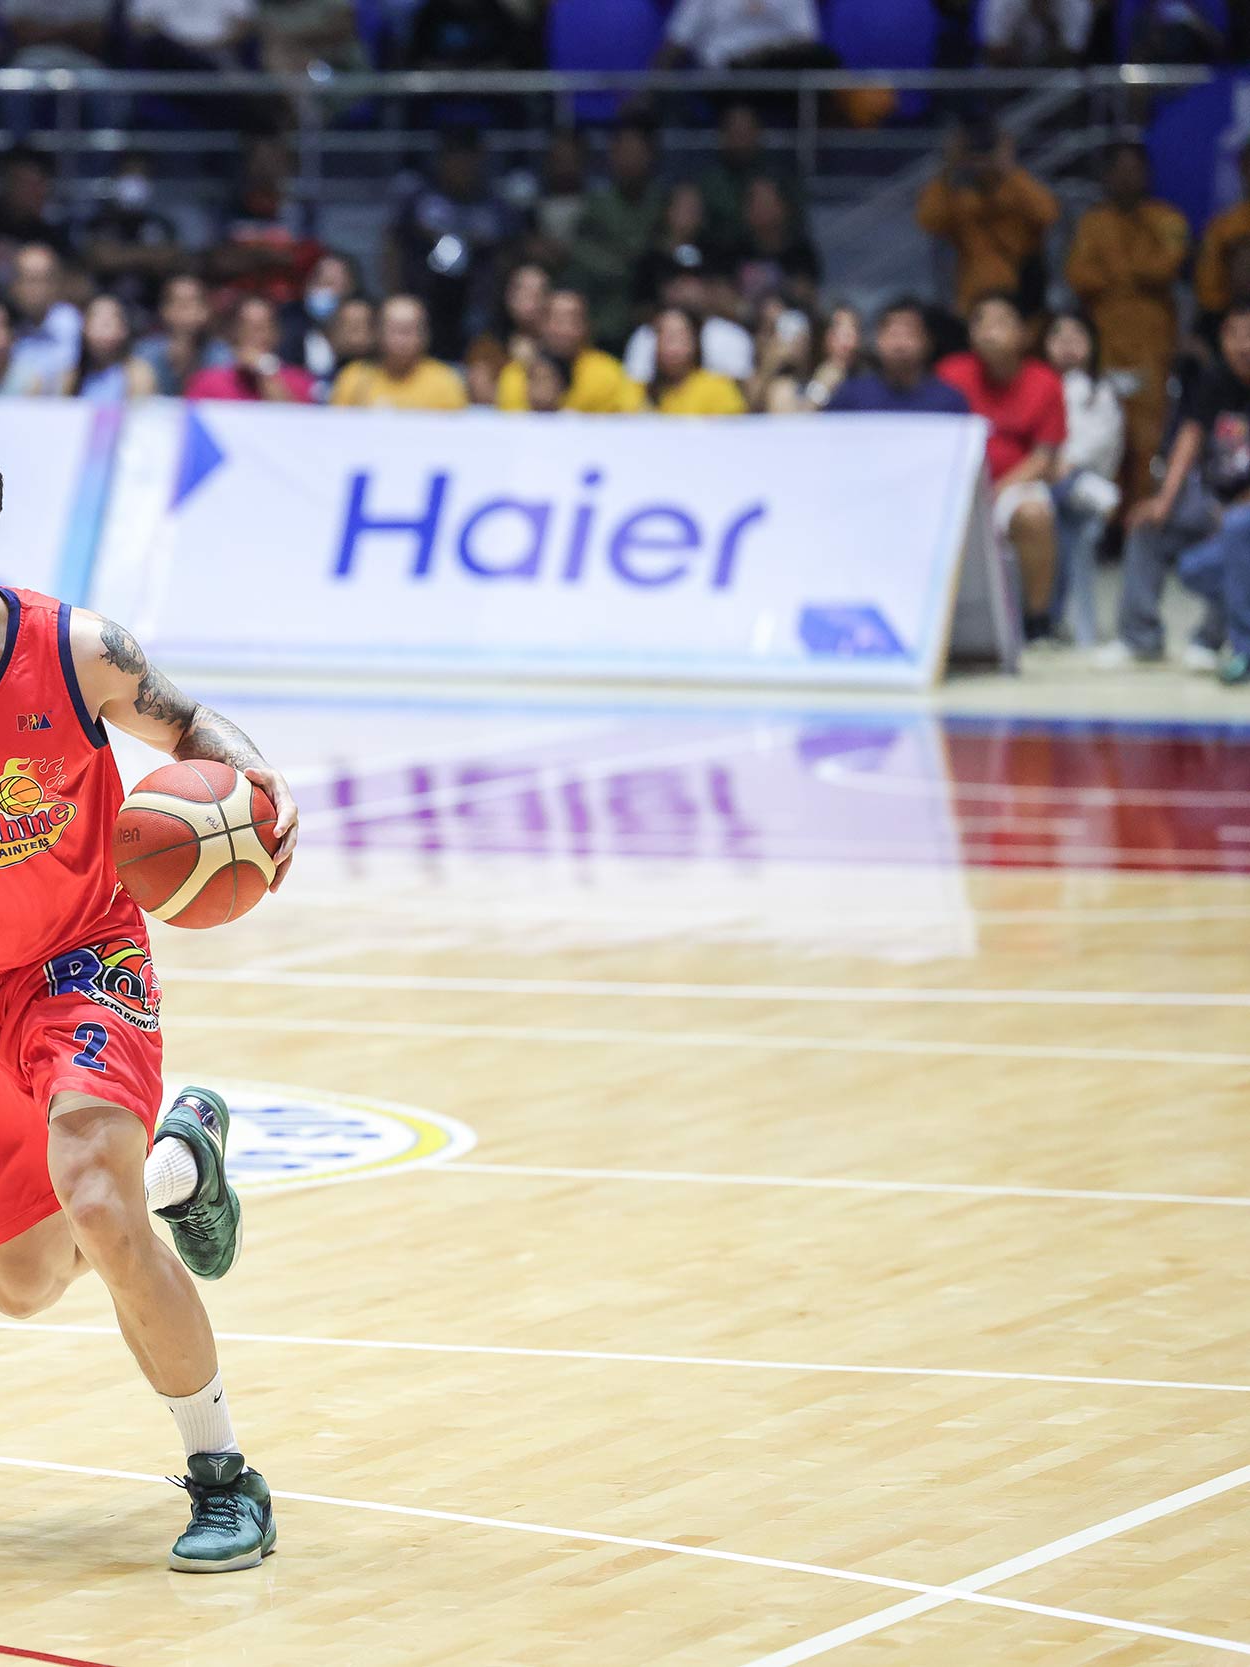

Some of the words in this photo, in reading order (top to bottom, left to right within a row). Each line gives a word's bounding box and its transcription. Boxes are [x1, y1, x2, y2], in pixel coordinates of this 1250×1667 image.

[334, 469, 766, 590] Haier
[16, 711, 54, 733] PBA
[123, 1010, 159, 1031] PAINT
[71, 1021, 109, 1073] 2
